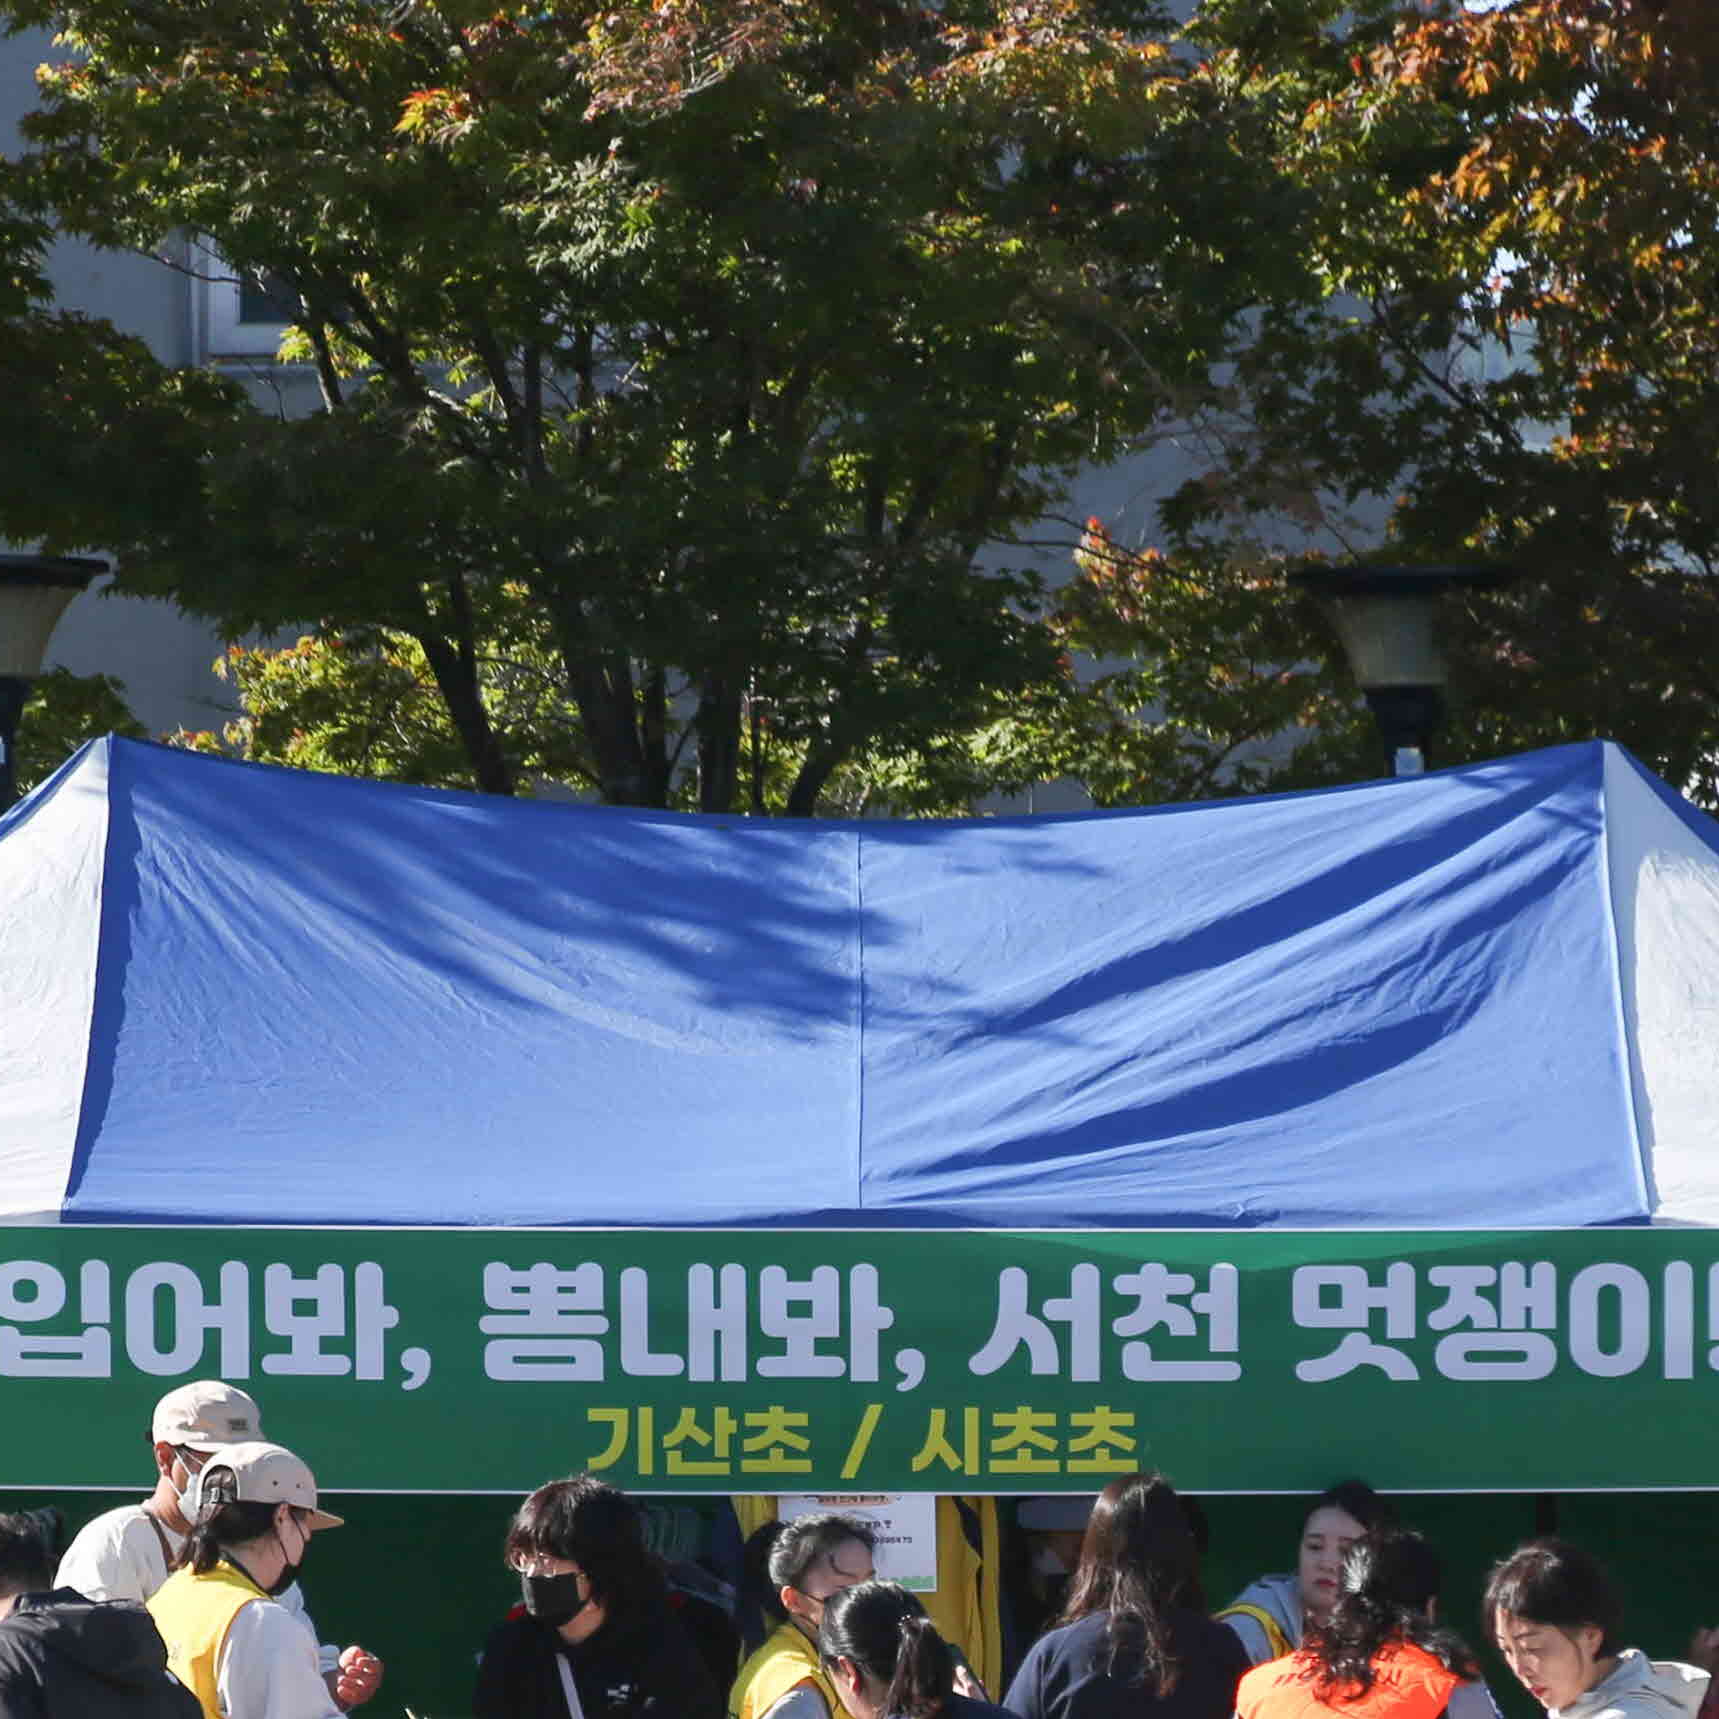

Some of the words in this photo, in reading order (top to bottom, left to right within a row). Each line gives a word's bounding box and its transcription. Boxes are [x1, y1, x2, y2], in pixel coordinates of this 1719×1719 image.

[478, 1261, 927, 1392] 뽐내봐,
[967, 1262, 1241, 1383] 서천
[586, 1405, 814, 1476] 기산초
[840, 1403, 884, 1480] /
[911, 1406, 1138, 1476] 시초초
